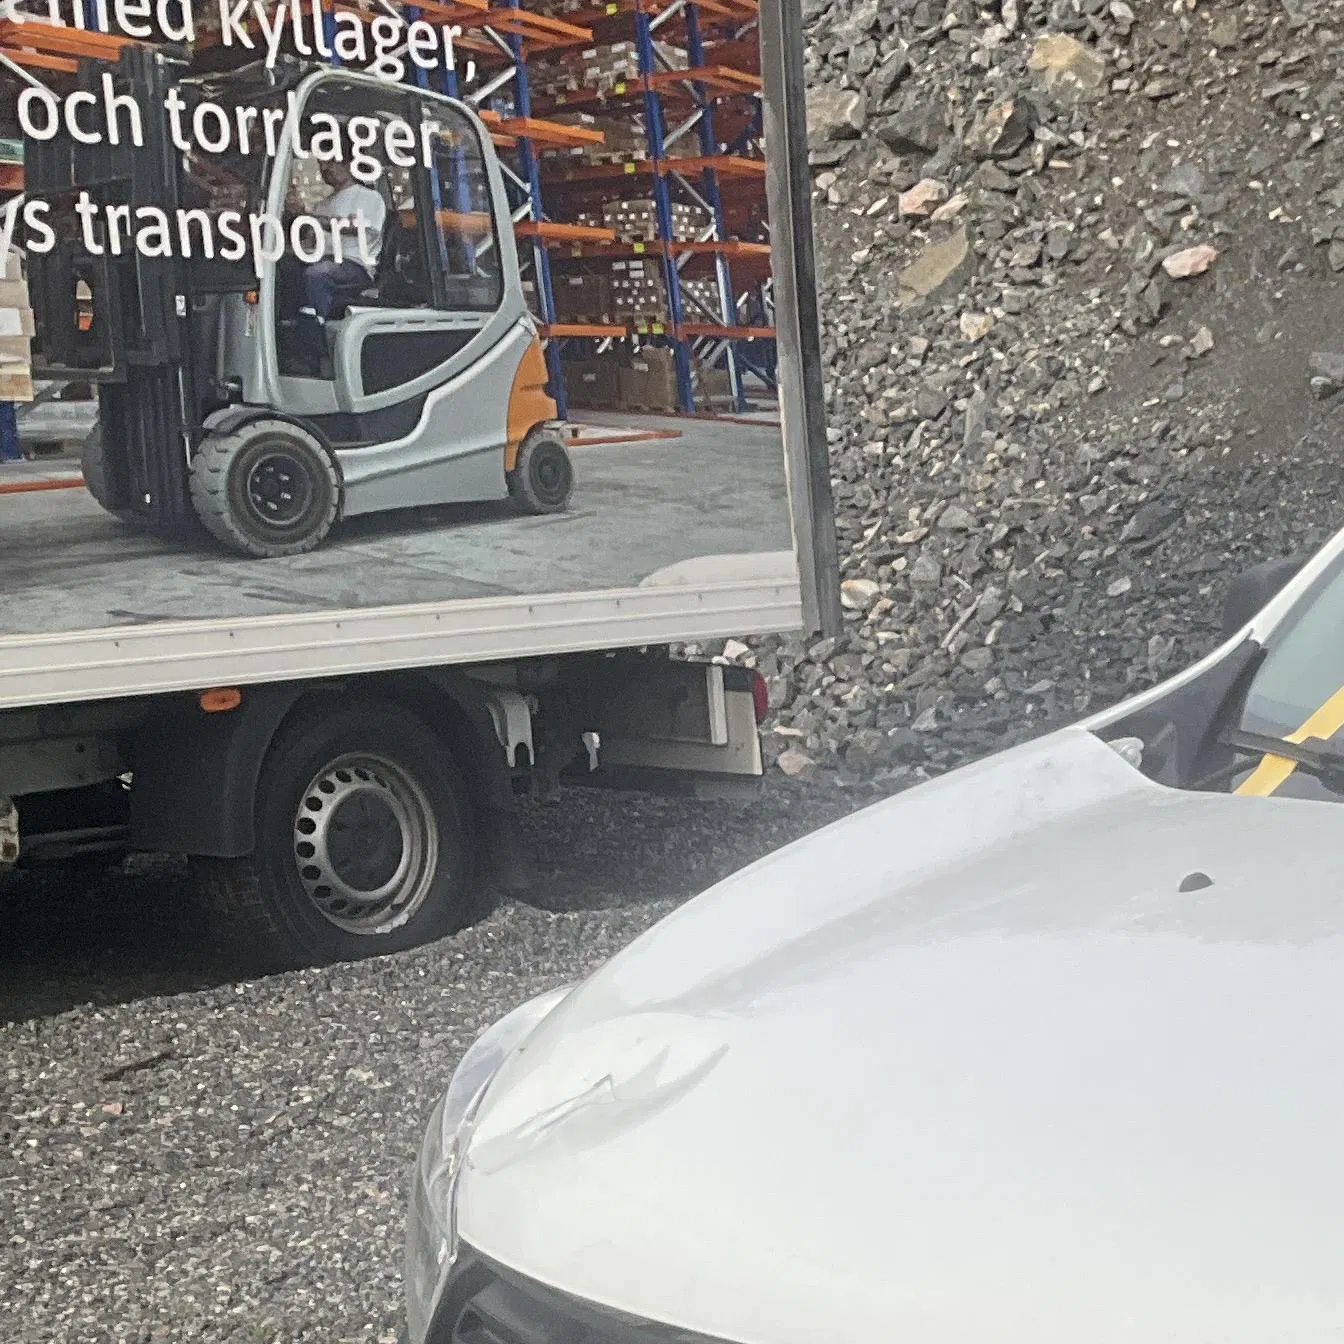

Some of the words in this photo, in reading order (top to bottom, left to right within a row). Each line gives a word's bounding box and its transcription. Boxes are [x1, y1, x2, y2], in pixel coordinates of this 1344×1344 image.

[217, 0, 475, 82] kyllager,
[17, 73, 143, 147] och
[164, 87, 441, 182] torrlager
[75, 191, 377, 279] transport
